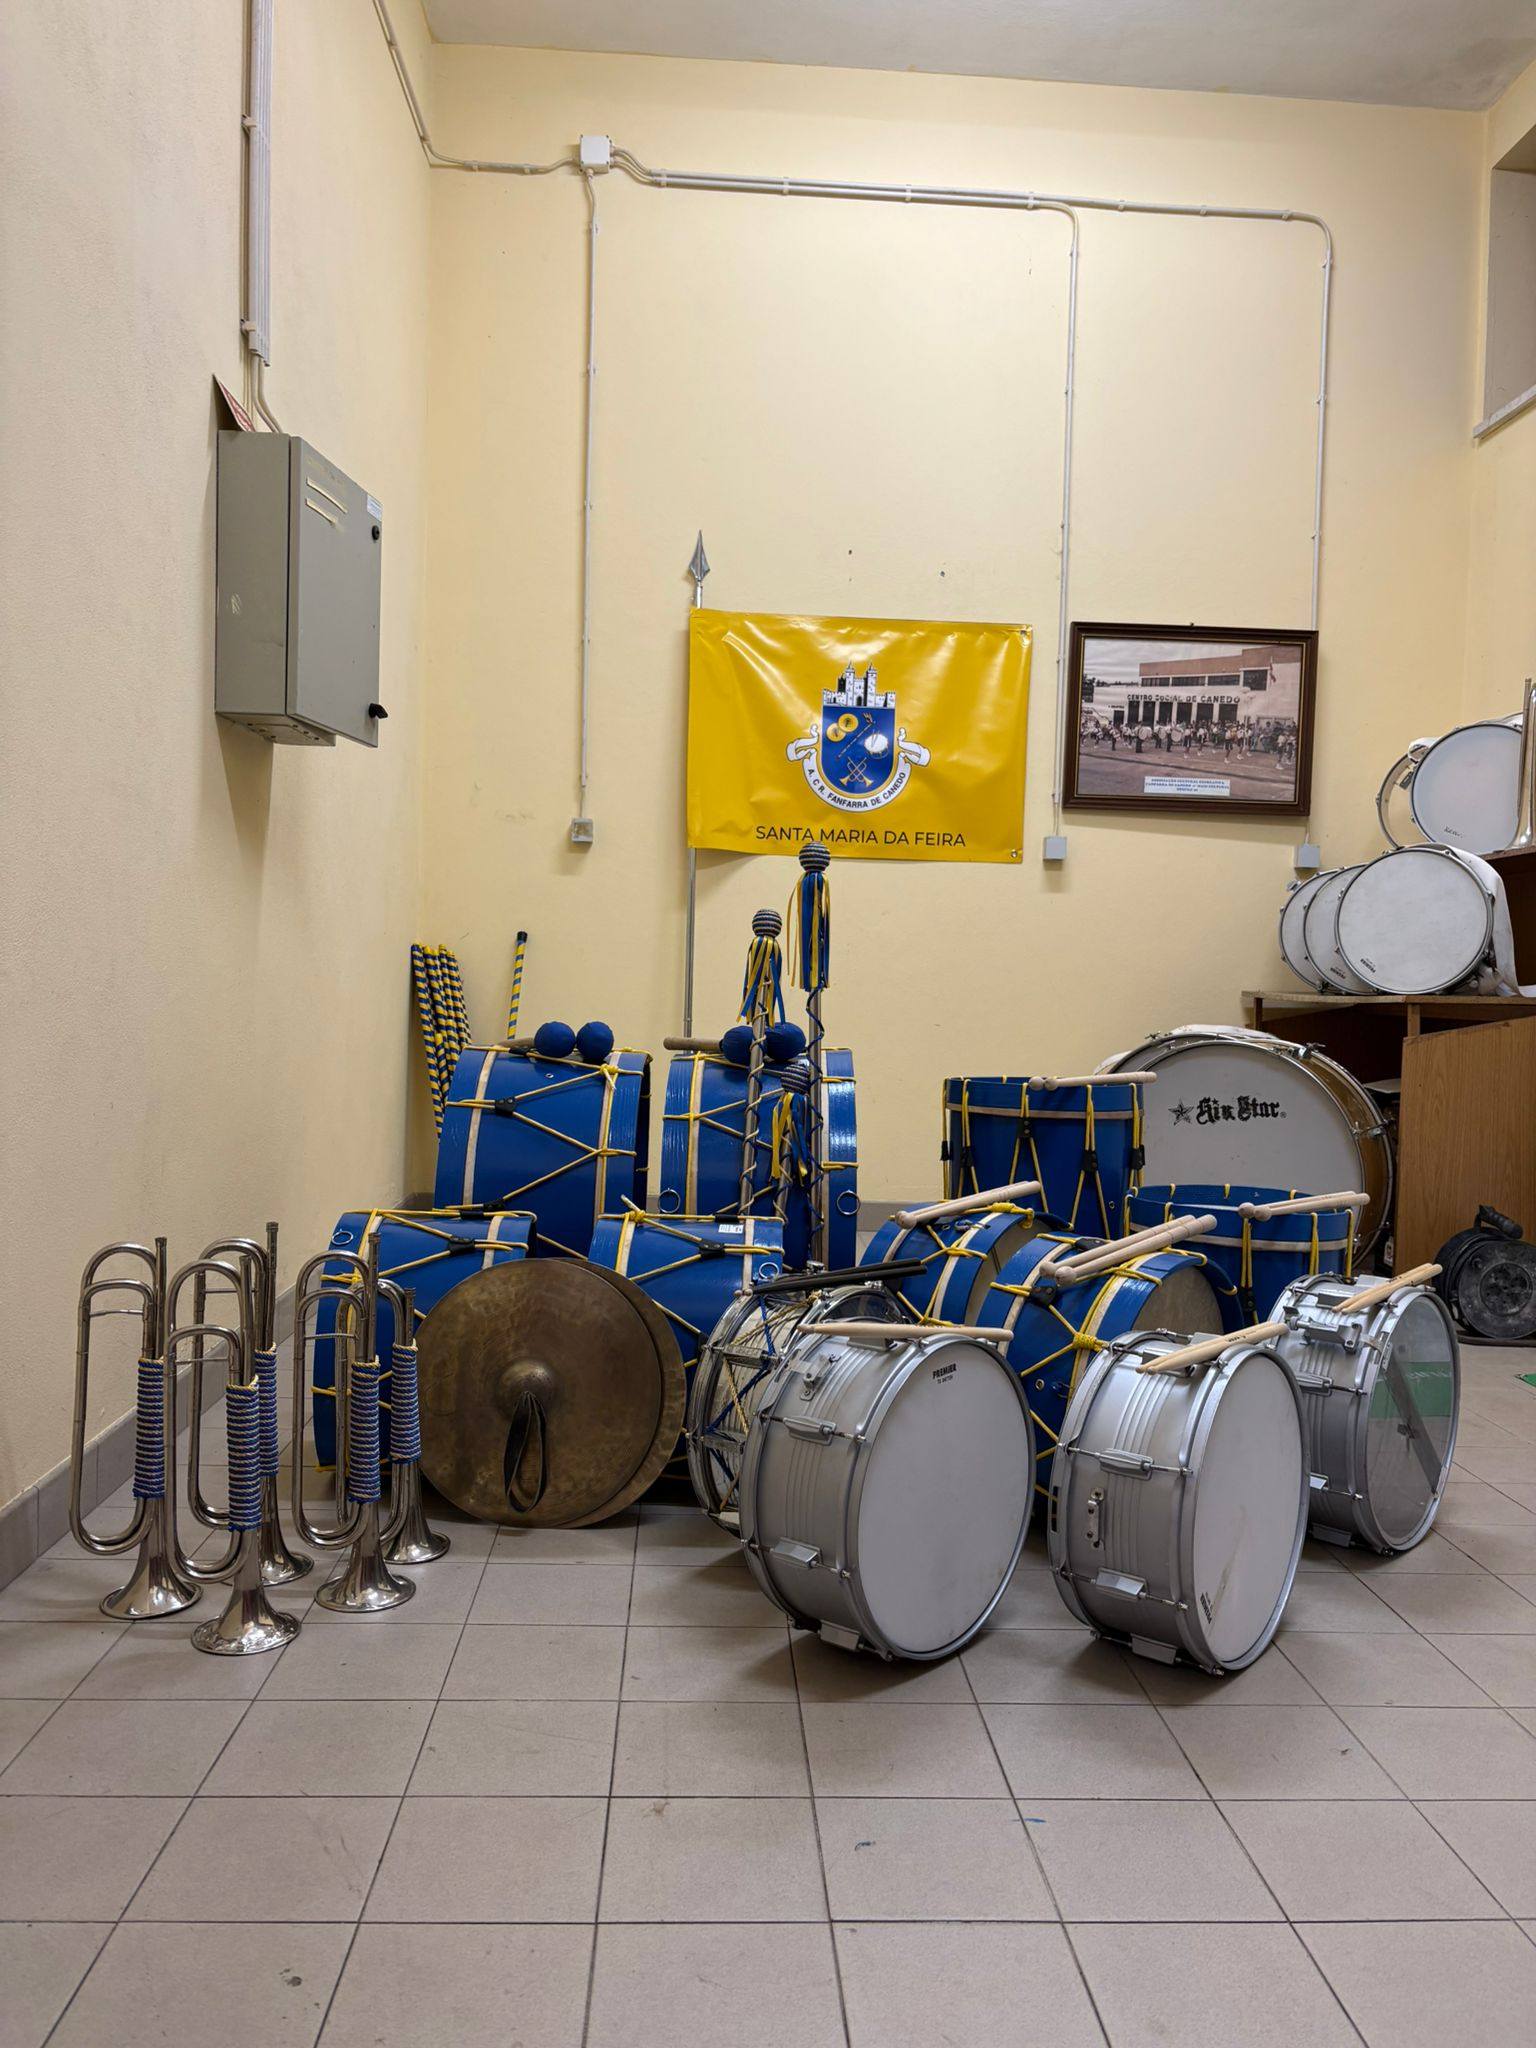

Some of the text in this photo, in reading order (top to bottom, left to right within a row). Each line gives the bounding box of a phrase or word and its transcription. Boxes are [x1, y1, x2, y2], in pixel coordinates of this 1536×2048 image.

[1201, 695, 1241, 704] CANEDO
[827, 792, 869, 808] FANFARRA
[871, 798, 882, 806] DE
[883, 772, 906, 799] CANEDO
[756, 825, 966, 847] SANTA MARIA DA FEIRA
[933, 1363, 957, 1379] PREMIER
